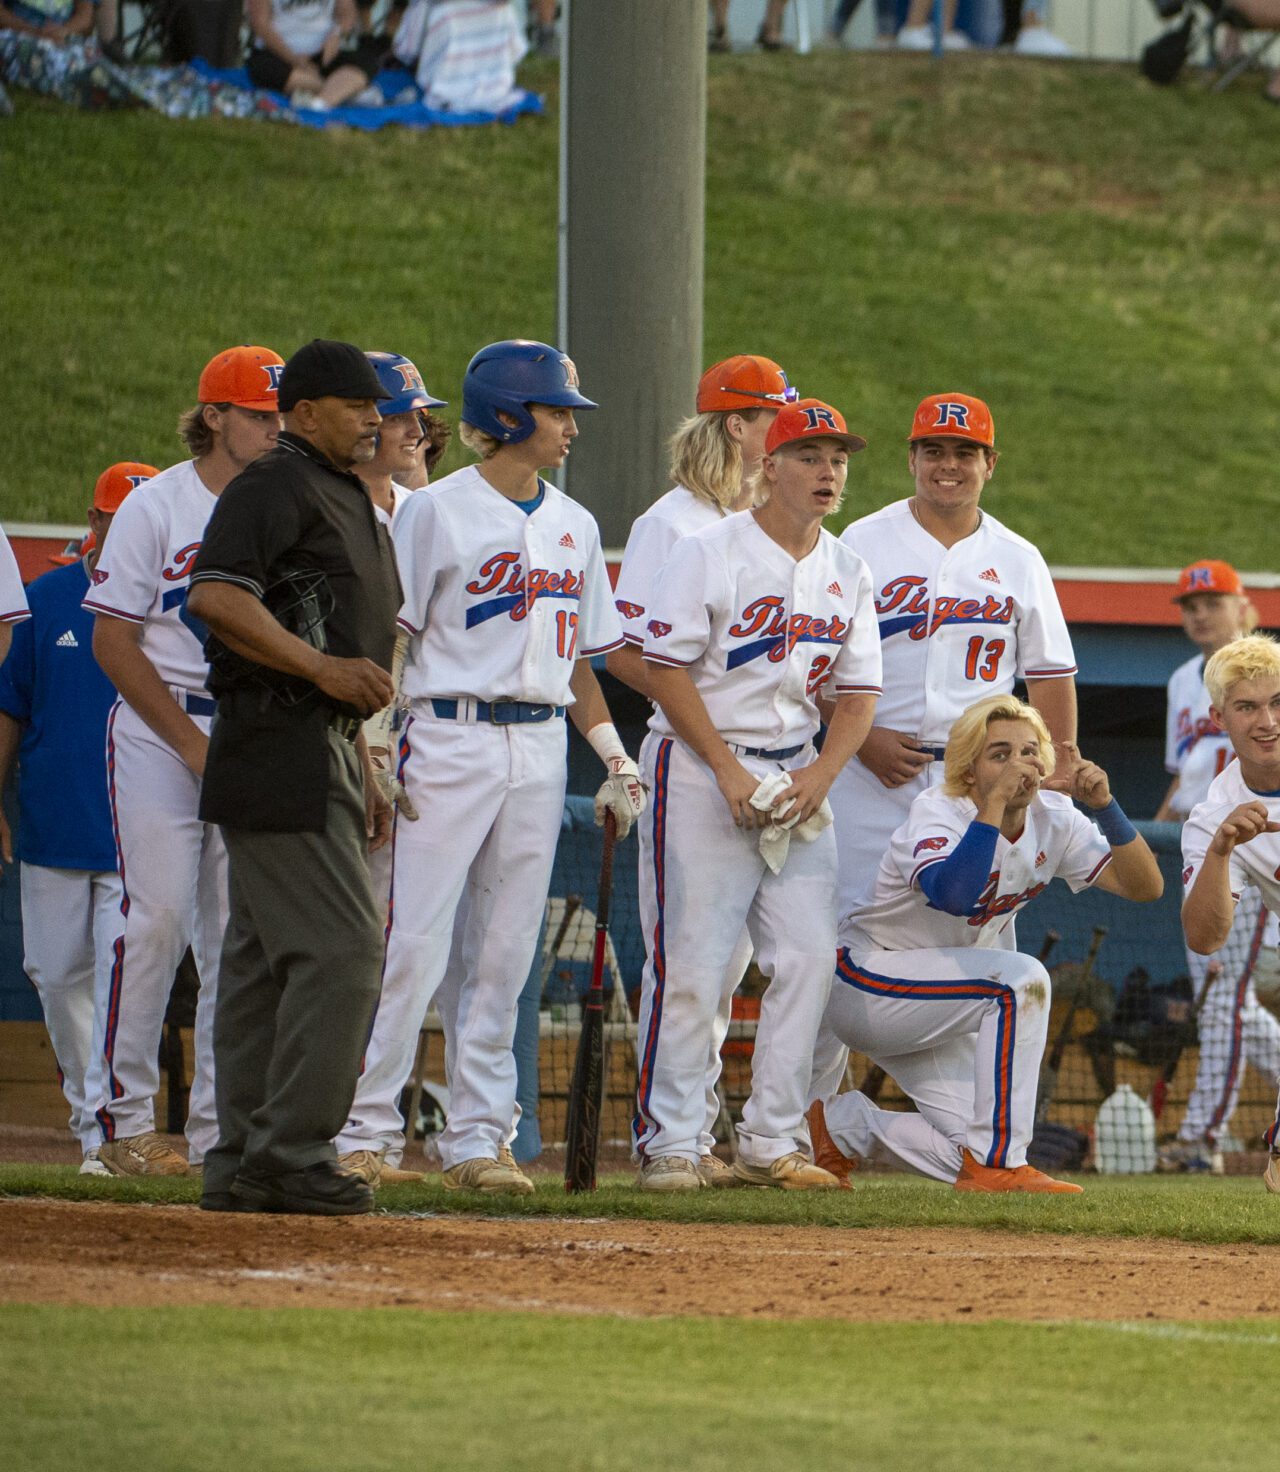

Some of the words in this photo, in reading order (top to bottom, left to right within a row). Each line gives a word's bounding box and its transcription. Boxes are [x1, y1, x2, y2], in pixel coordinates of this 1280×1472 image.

[392, 363, 426, 392] R
[799, 406, 842, 433] R
[931, 402, 971, 431] R
[1187, 567, 1216, 592] R
[874, 575, 1014, 641] Tigers
[56, 639, 79, 647] adidas
[556, 610, 579, 661] 17
[728, 595, 848, 663] Tiger
[965, 635, 1006, 682] 13
[806, 654, 833, 697] 2
[1214, 748, 1238, 779] 1
